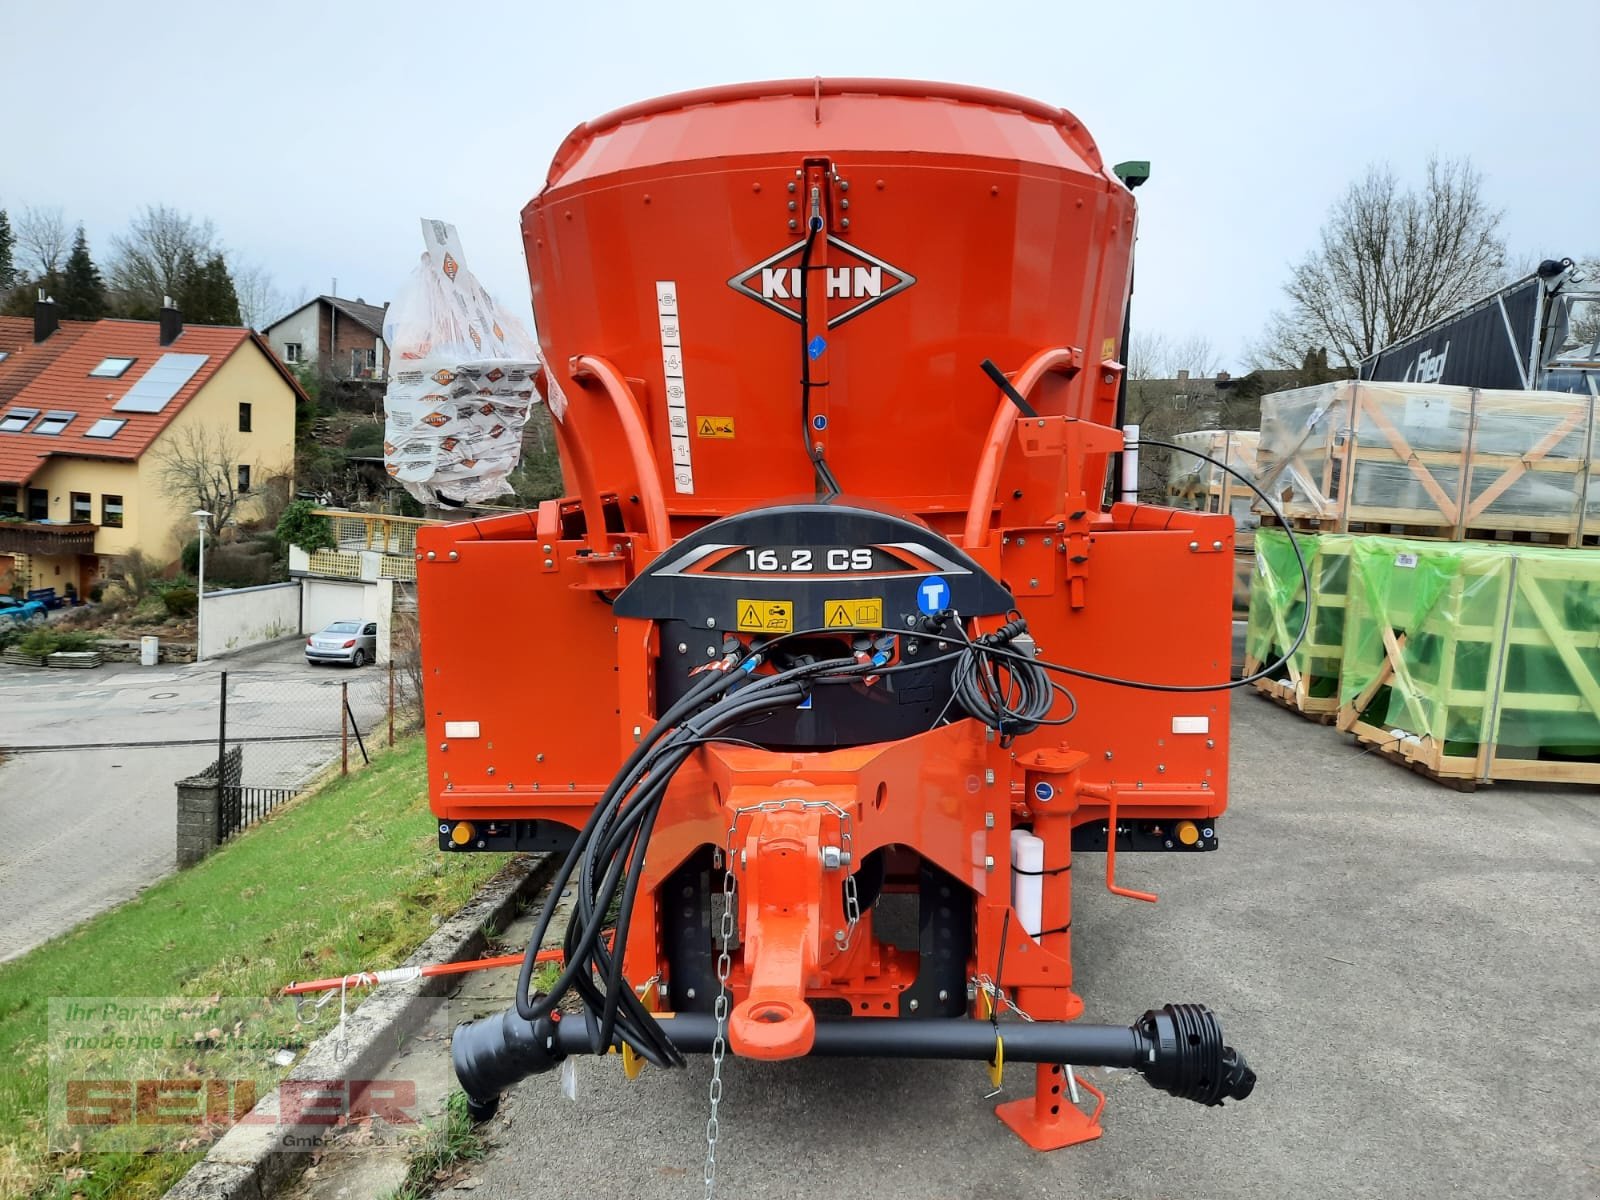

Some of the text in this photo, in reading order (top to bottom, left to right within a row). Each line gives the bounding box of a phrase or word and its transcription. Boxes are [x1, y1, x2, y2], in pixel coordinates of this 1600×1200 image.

[668, 354, 679, 369] 4
[669, 385, 682, 398] 3
[672, 416, 684, 428] 2
[677, 445, 686, 456] 1
[677, 473, 690, 485] 0
[746, 548, 874, 572] 16.2 CS
[922, 585, 944, 610] T
